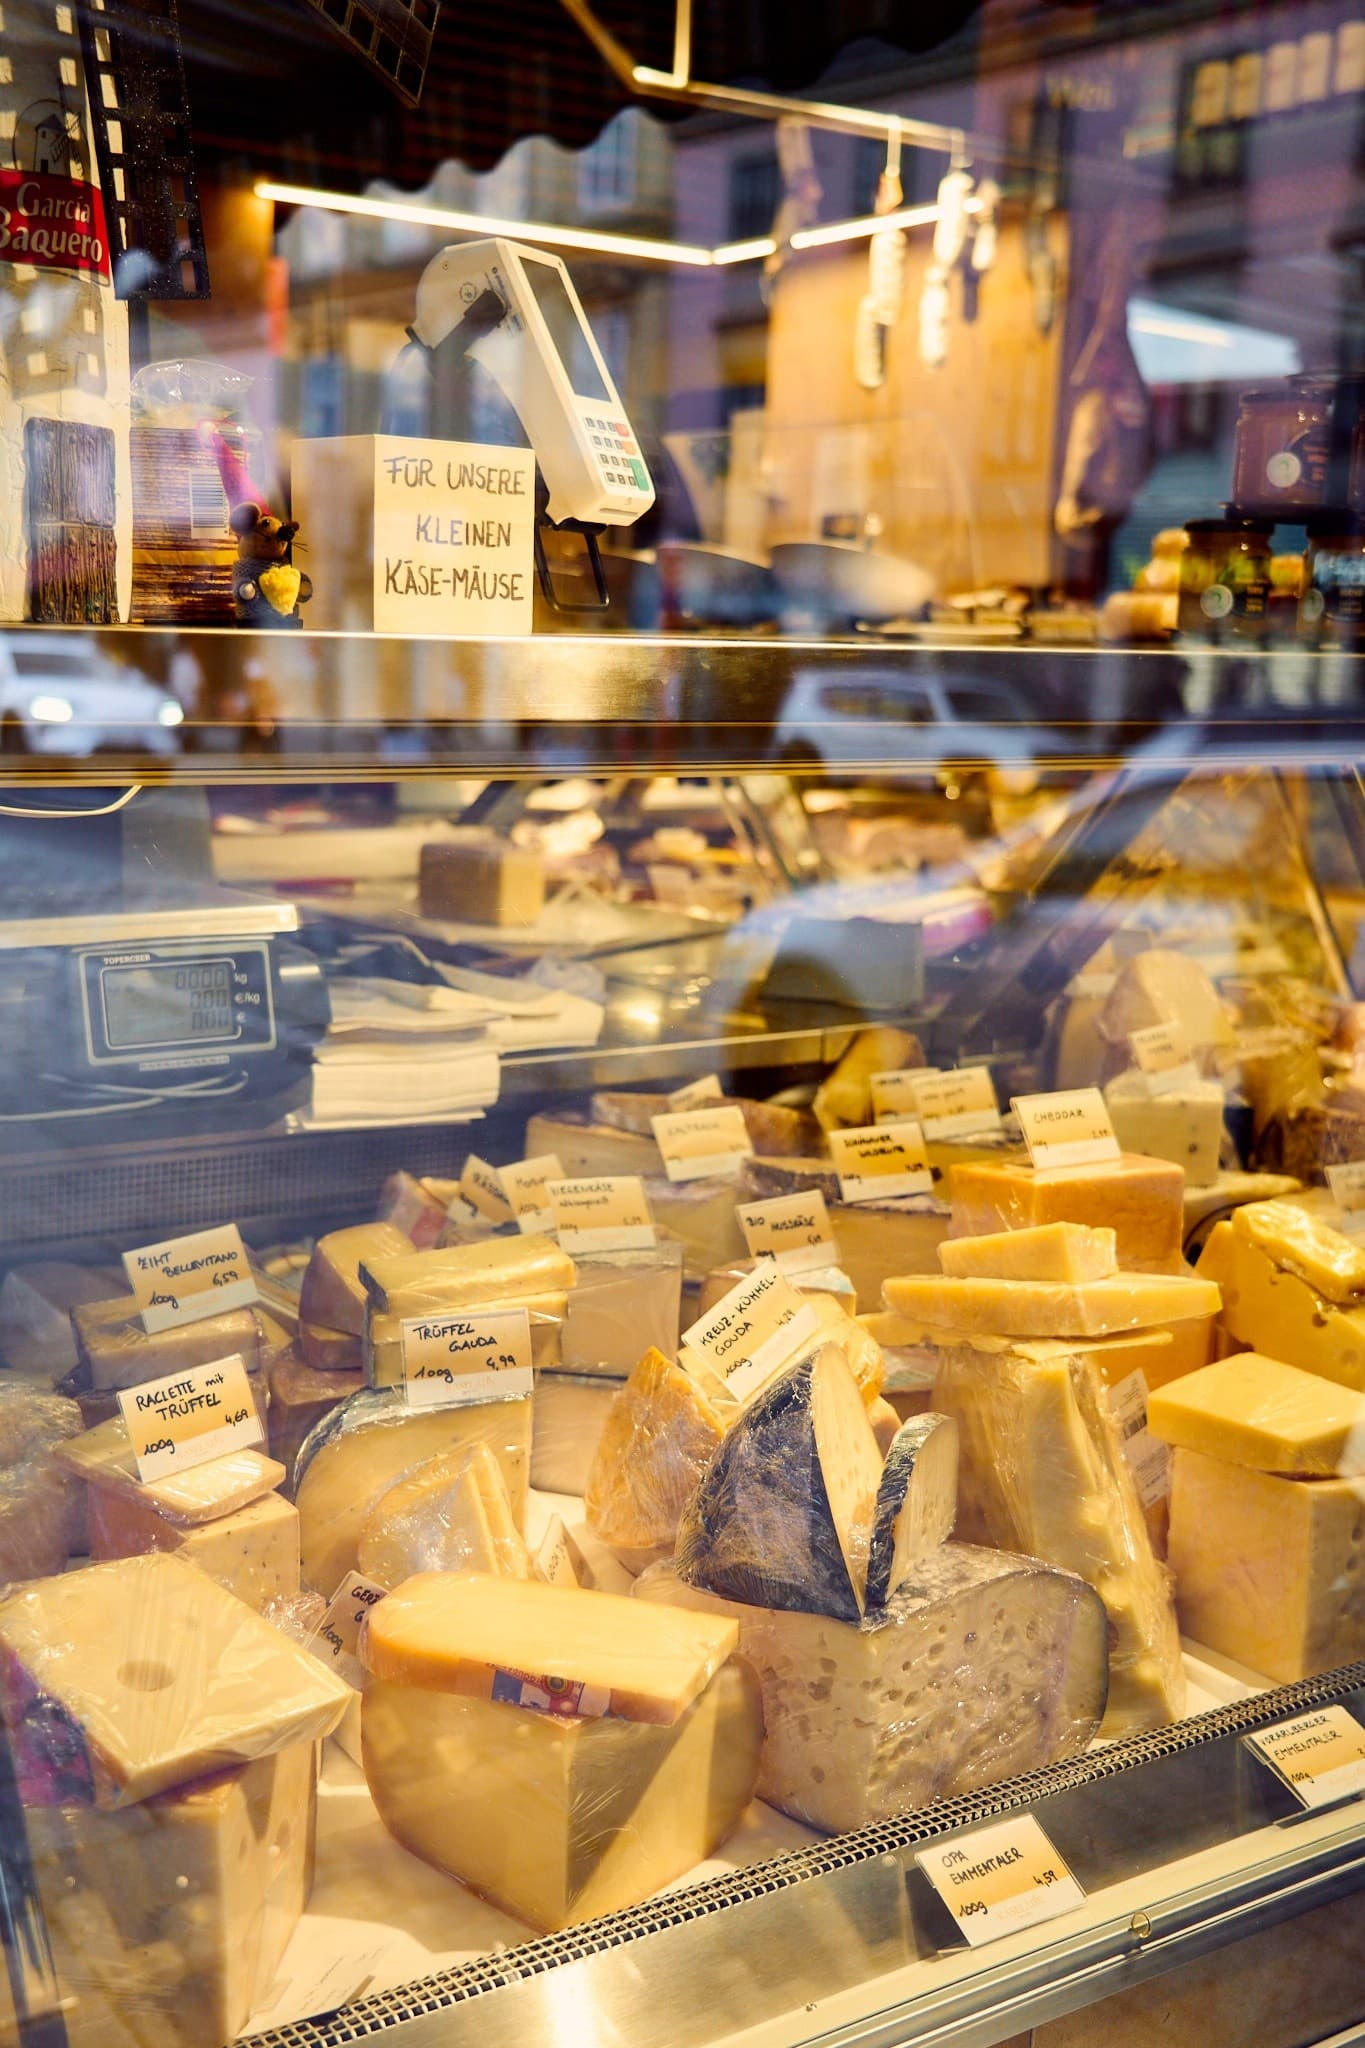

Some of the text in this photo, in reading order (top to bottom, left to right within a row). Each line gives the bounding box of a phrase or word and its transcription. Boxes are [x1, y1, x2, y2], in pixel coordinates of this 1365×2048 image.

[383, 456, 526, 495] FÜR UNSERE
[416, 513, 512, 548] KLEINEN
[385, 557, 525, 601] KÄSE-MÄUSE
[234, 972, 248, 984] kg
[1034, 1109, 1085, 1124] CHEDDAR
[149, 1291, 179, 1310] 100g
[412, 1323, 476, 1341] TRÜFFEL
[714, 1321, 754, 1358] GOUDA
[413, 1366, 454, 1384] 100g
[135, 1373, 225, 1412] RACLETTE mit
[155, 1393, 222, 1421] TRÜFFEL
[143, 1439, 176, 1456] 100g
[320, 1622, 344, 1656] 100g
[1273, 1729, 1343, 1761] EMMENTALER
[941, 1850, 969, 1868] OPA
[949, 1847, 1024, 1886] EMMENTALER
[1032, 1869, 1060, 1887] 4,59
[959, 1901, 989, 1918] 100g
